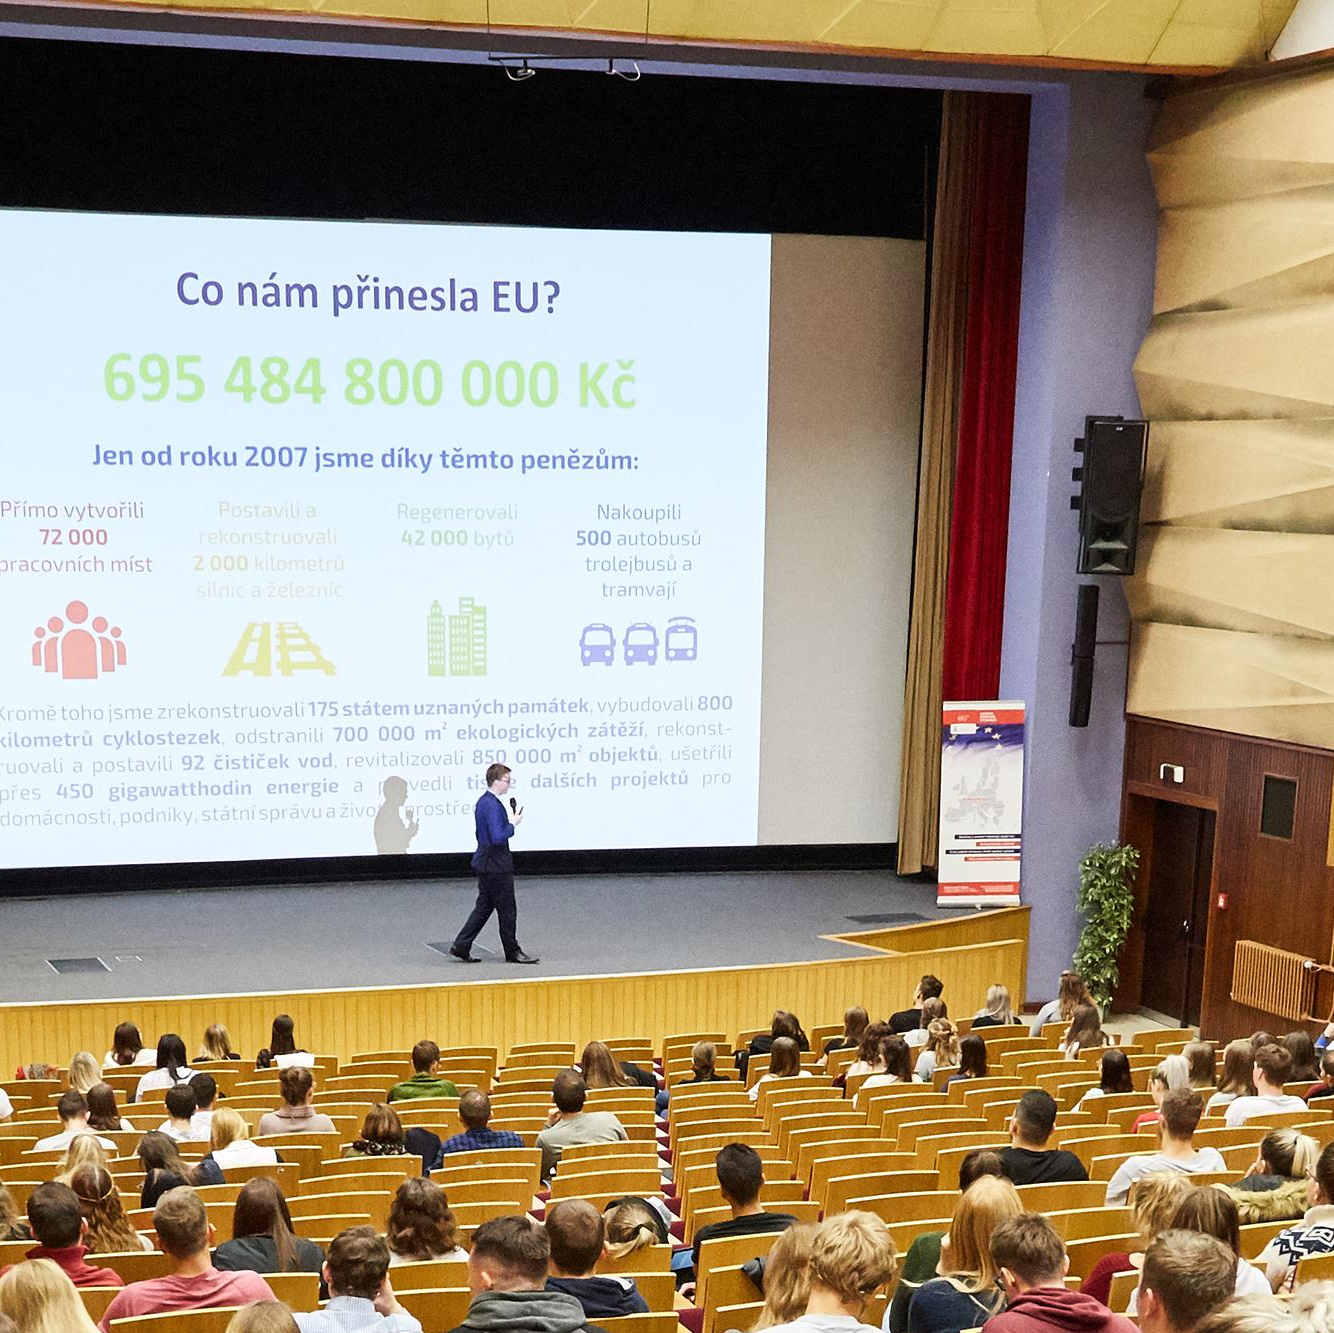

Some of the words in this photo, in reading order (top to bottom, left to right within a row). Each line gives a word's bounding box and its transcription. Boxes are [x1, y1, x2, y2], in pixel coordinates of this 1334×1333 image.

[177, 272, 223, 306] Co
[238, 272, 318, 308] nám
[333, 274, 478, 317] přinesla
[493, 280, 560, 314] EU?
[105, 353, 204, 403] 695
[225, 356, 326, 404] 484
[345, 358, 443, 406] 800
[462, 360, 558, 408] 000
[580, 360, 635, 408] Kč
[93, 445, 133, 465] Jen
[142, 445, 171, 466] od
[181, 446, 237, 466] roku
[245, 446, 307, 467] 2007
[315, 446, 373, 472] jsme
[382, 447, 433, 474] díky
[440, 448, 513, 469] těmto
[522, 448, 638, 474] penězům:
[0, 500, 58, 518] Přímo
[64, 501, 143, 522] vytvořili
[219, 501, 300, 518] Postavili
[306, 506, 316, 520] a
[397, 503, 517, 524] Regenerovali
[598, 504, 681, 524] Nakoupili
[39, 529, 63, 545] 72
[68, 529, 108, 545] 000
[199, 528, 337, 545] rekonstruovali
[401, 529, 425, 546] 42
[431, 528, 468, 546] 000
[474, 529, 514, 550] bytů
[576, 529, 611, 546] 500
[617, 529, 701, 546] autobusů
[111, 555, 153, 572] míst
[192, 555, 204, 574] 2
[209, 554, 250, 572] 000
[255, 555, 345, 572] kilometrů
[585, 555, 676, 575] trolejbusů
[683, 560, 691, 571] a
[196, 582, 244, 598] silnic
[251, 586, 261, 597] a
[267, 581, 344, 598] železnic
[602, 580, 677, 600] tramvají
[61, 704, 103, 720] toho
[109, 704, 152, 723] jsme
[157, 701, 304, 719] zrekonstruovali
[308, 701, 338, 717] 175
[343, 700, 409, 716] státem
[414, 698, 503, 719] uznaných
[508, 697, 593, 718] památek,
[597, 696, 693, 716] vybudovali
[698, 696, 732, 711] 800
[103, 729, 225, 750] cyklostezek,
[235, 727, 323, 744] odstranili
[333, 726, 368, 742] 700
[379, 726, 415, 741] 000
[457, 722, 578, 743] ekologických
[588, 721, 647, 738] zátěží,
[658, 721, 731, 736] rekonst-
[73, 762, 82, 773] a
[93, 756, 172, 776] postavili
[182, 755, 205, 771] 92
[214, 753, 289, 770] čističek
[298, 752, 337, 769] vod,
[347, 750, 463, 768] revitalizovali
[472, 749, 507, 765] 850
[516, 749, 551, 764] 000
[589, 745, 662, 765] objektů,
[671, 745, 731, 760] ušetřili
[0, 784, 41, 804] přes
[56, 783, 93, 799] 450
[108, 780, 251, 802] gigawatthodin
[267, 778, 338, 797] energie
[354, 781, 362, 792] a
[531, 772, 596, 788] dalších
[611, 769, 688, 791] projektů
[703, 773, 731, 788] pro
[0, 808, 115, 826] domácnosti,
[120, 807, 197, 827] podniky,
[202, 805, 256, 821] státní
[259, 804, 321, 824] správu
[326, 807, 335, 818] a
